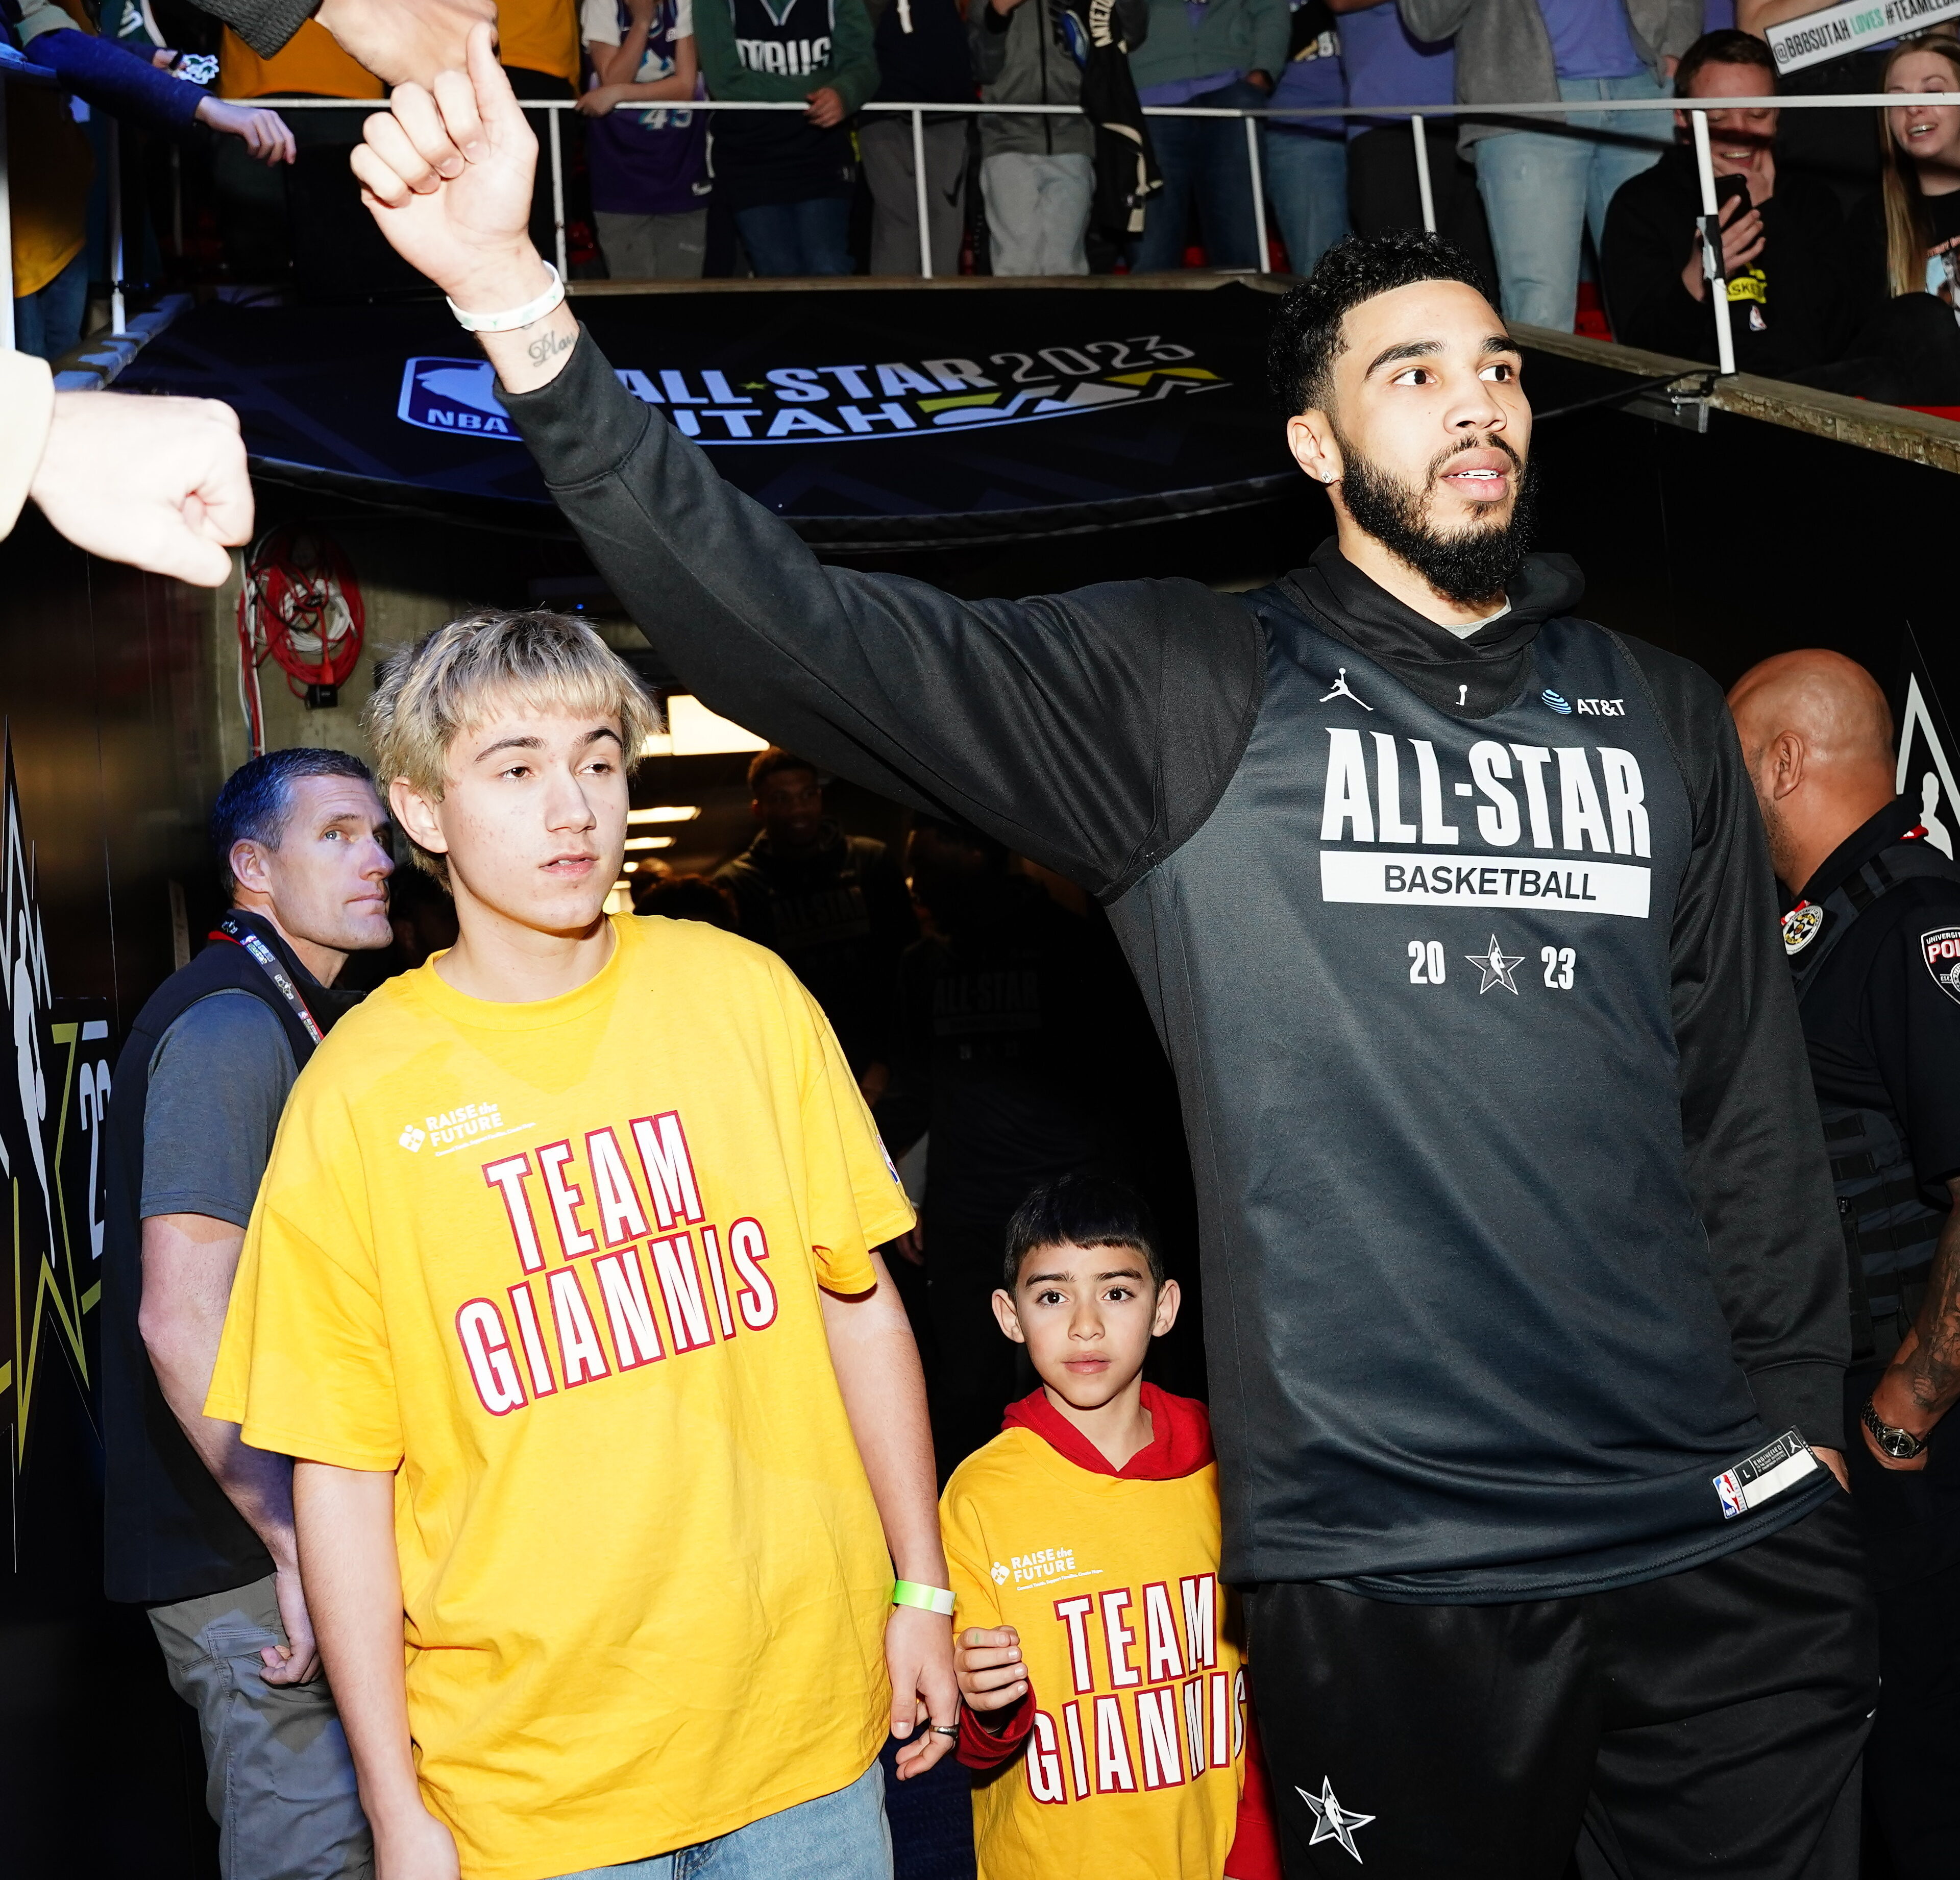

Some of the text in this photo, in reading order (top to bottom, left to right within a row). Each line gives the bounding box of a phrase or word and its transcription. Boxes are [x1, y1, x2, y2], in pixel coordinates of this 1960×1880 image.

[1773, 18, 1852, 63] @BBBSUTAH
[1850, 8, 1885, 35] LOVES
[990, 335, 1195, 383] 2023
[427, 408, 508, 433] NBA
[1577, 699, 1625, 716] AT&T
[1320, 727, 1651, 859] ALL-STAR
[1384, 865, 1596, 901] BASKETBALL
[1408, 940, 1576, 990] 20 23
[425, 1102, 498, 1131] RAISE the
[430, 1113, 504, 1146] FUTURE
[481, 1110, 705, 1276] TEAM
[455, 1216, 778, 1416] GIANNIS
[1742, 1469, 1751, 1479] L
[1011, 1547, 1072, 1570] RAISE the
[1013, 1557, 1076, 1582] FUTURE
[1053, 1572, 1217, 1695] TEAM
